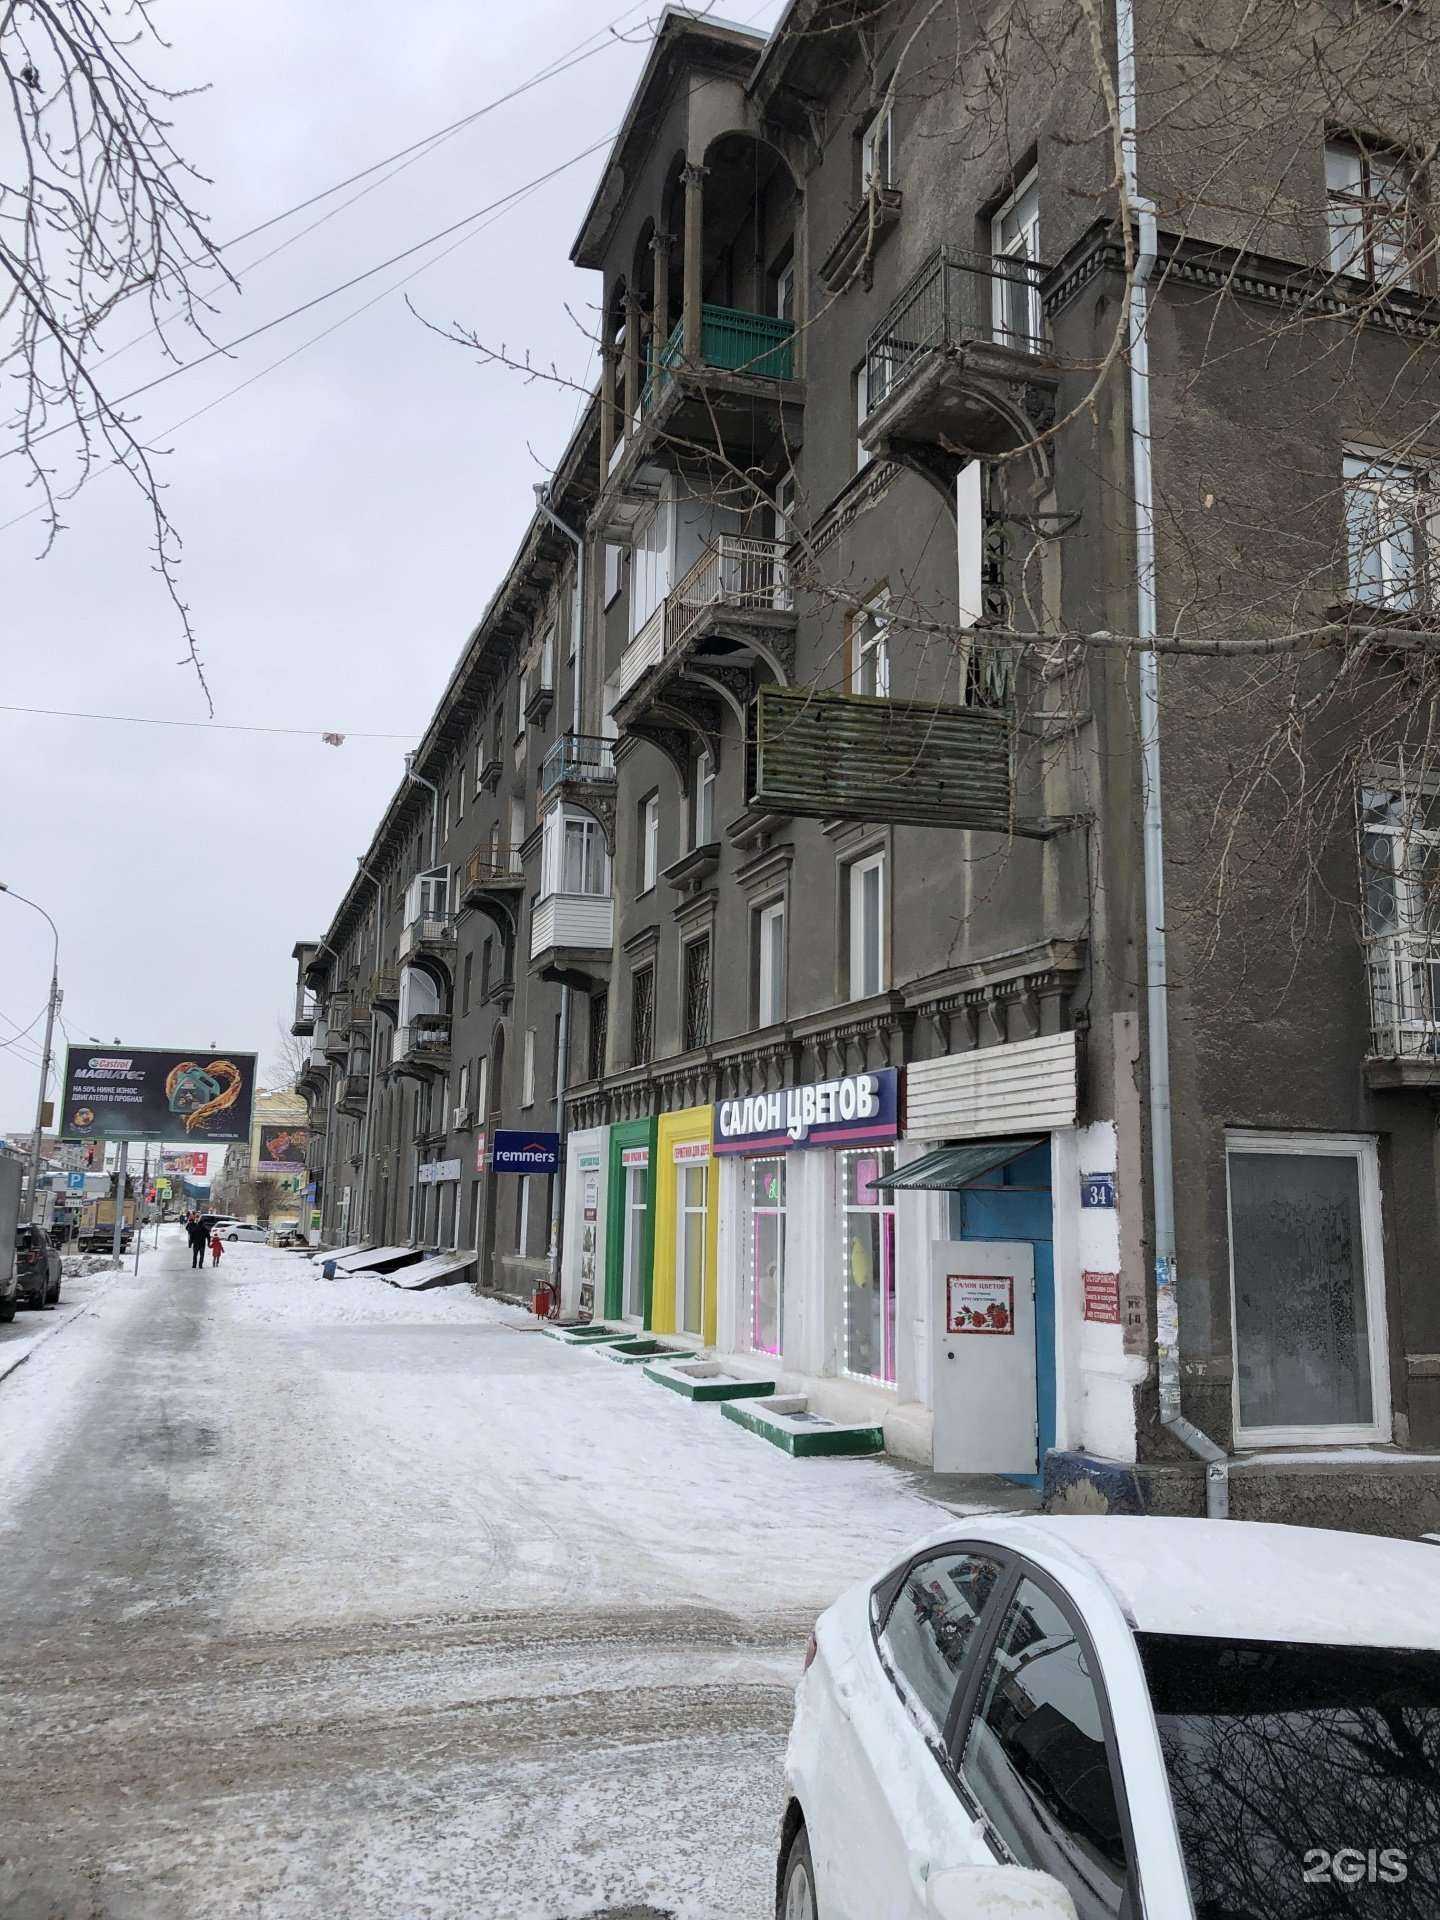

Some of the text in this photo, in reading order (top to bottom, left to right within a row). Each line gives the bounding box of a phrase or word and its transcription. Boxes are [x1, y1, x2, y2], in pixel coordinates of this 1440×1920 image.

[99, 1059, 129, 1069] Castrol
[74, 1069, 146, 1081] MAGNATEC
[720, 1075, 879, 1140] САЛОН ЦВЕТОВ
[496, 1151, 555, 1162] remmers
[1090, 1186, 1106, 1204] 34
